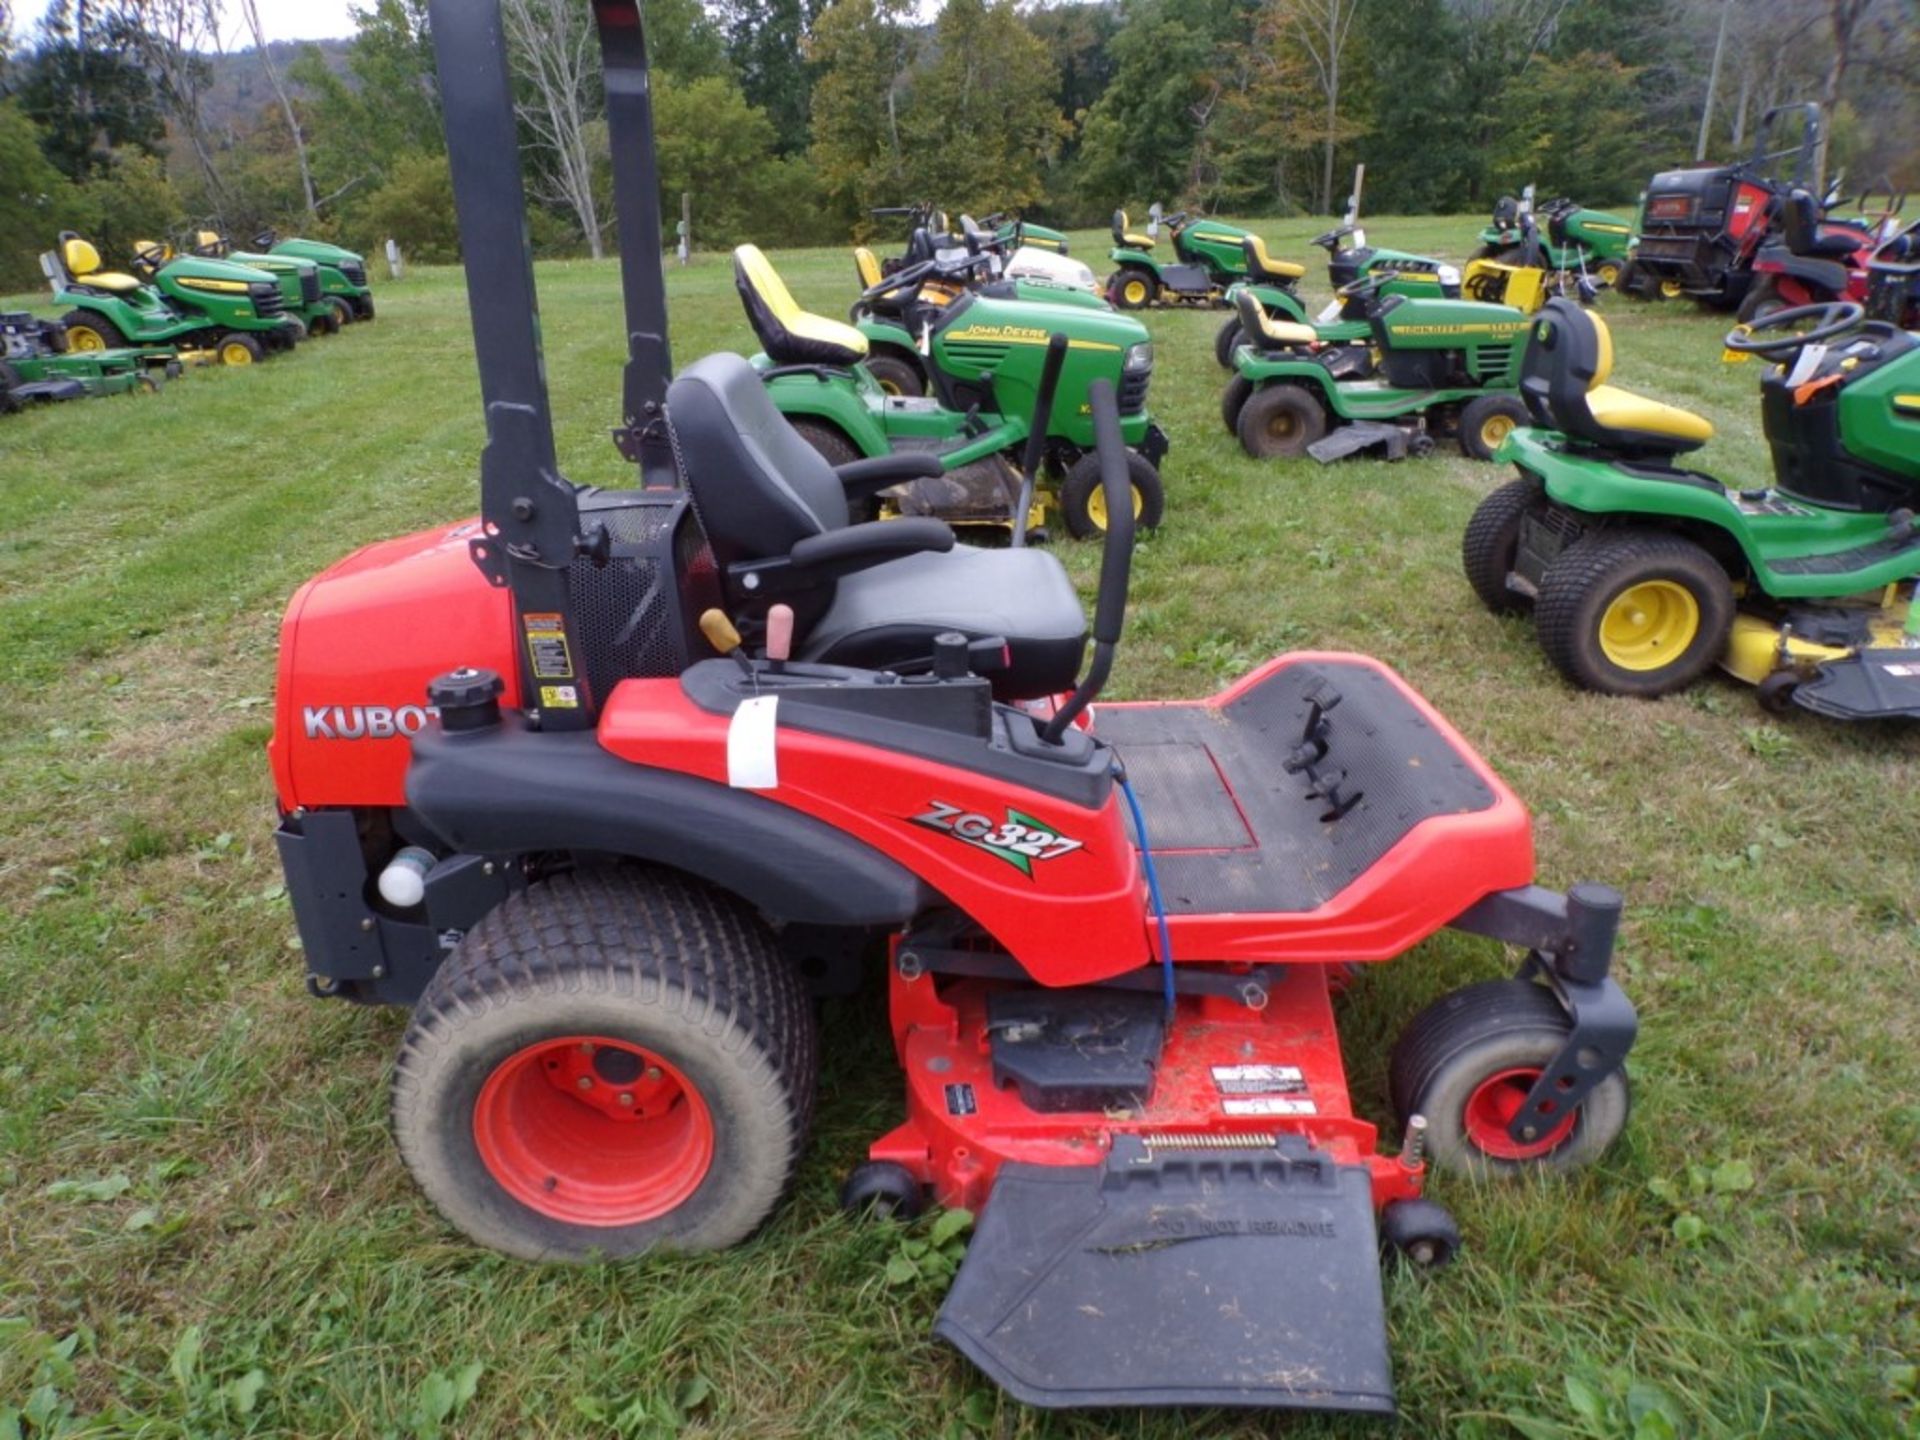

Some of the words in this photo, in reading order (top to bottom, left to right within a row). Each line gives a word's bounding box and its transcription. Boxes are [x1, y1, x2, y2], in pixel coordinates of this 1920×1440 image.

[968, 324, 1000, 336] JOHN
[1002, 325, 1048, 339] DEERE
[1200, 1220, 1240, 1235] NOT
[1249, 1220, 1338, 1238] REMOVE
